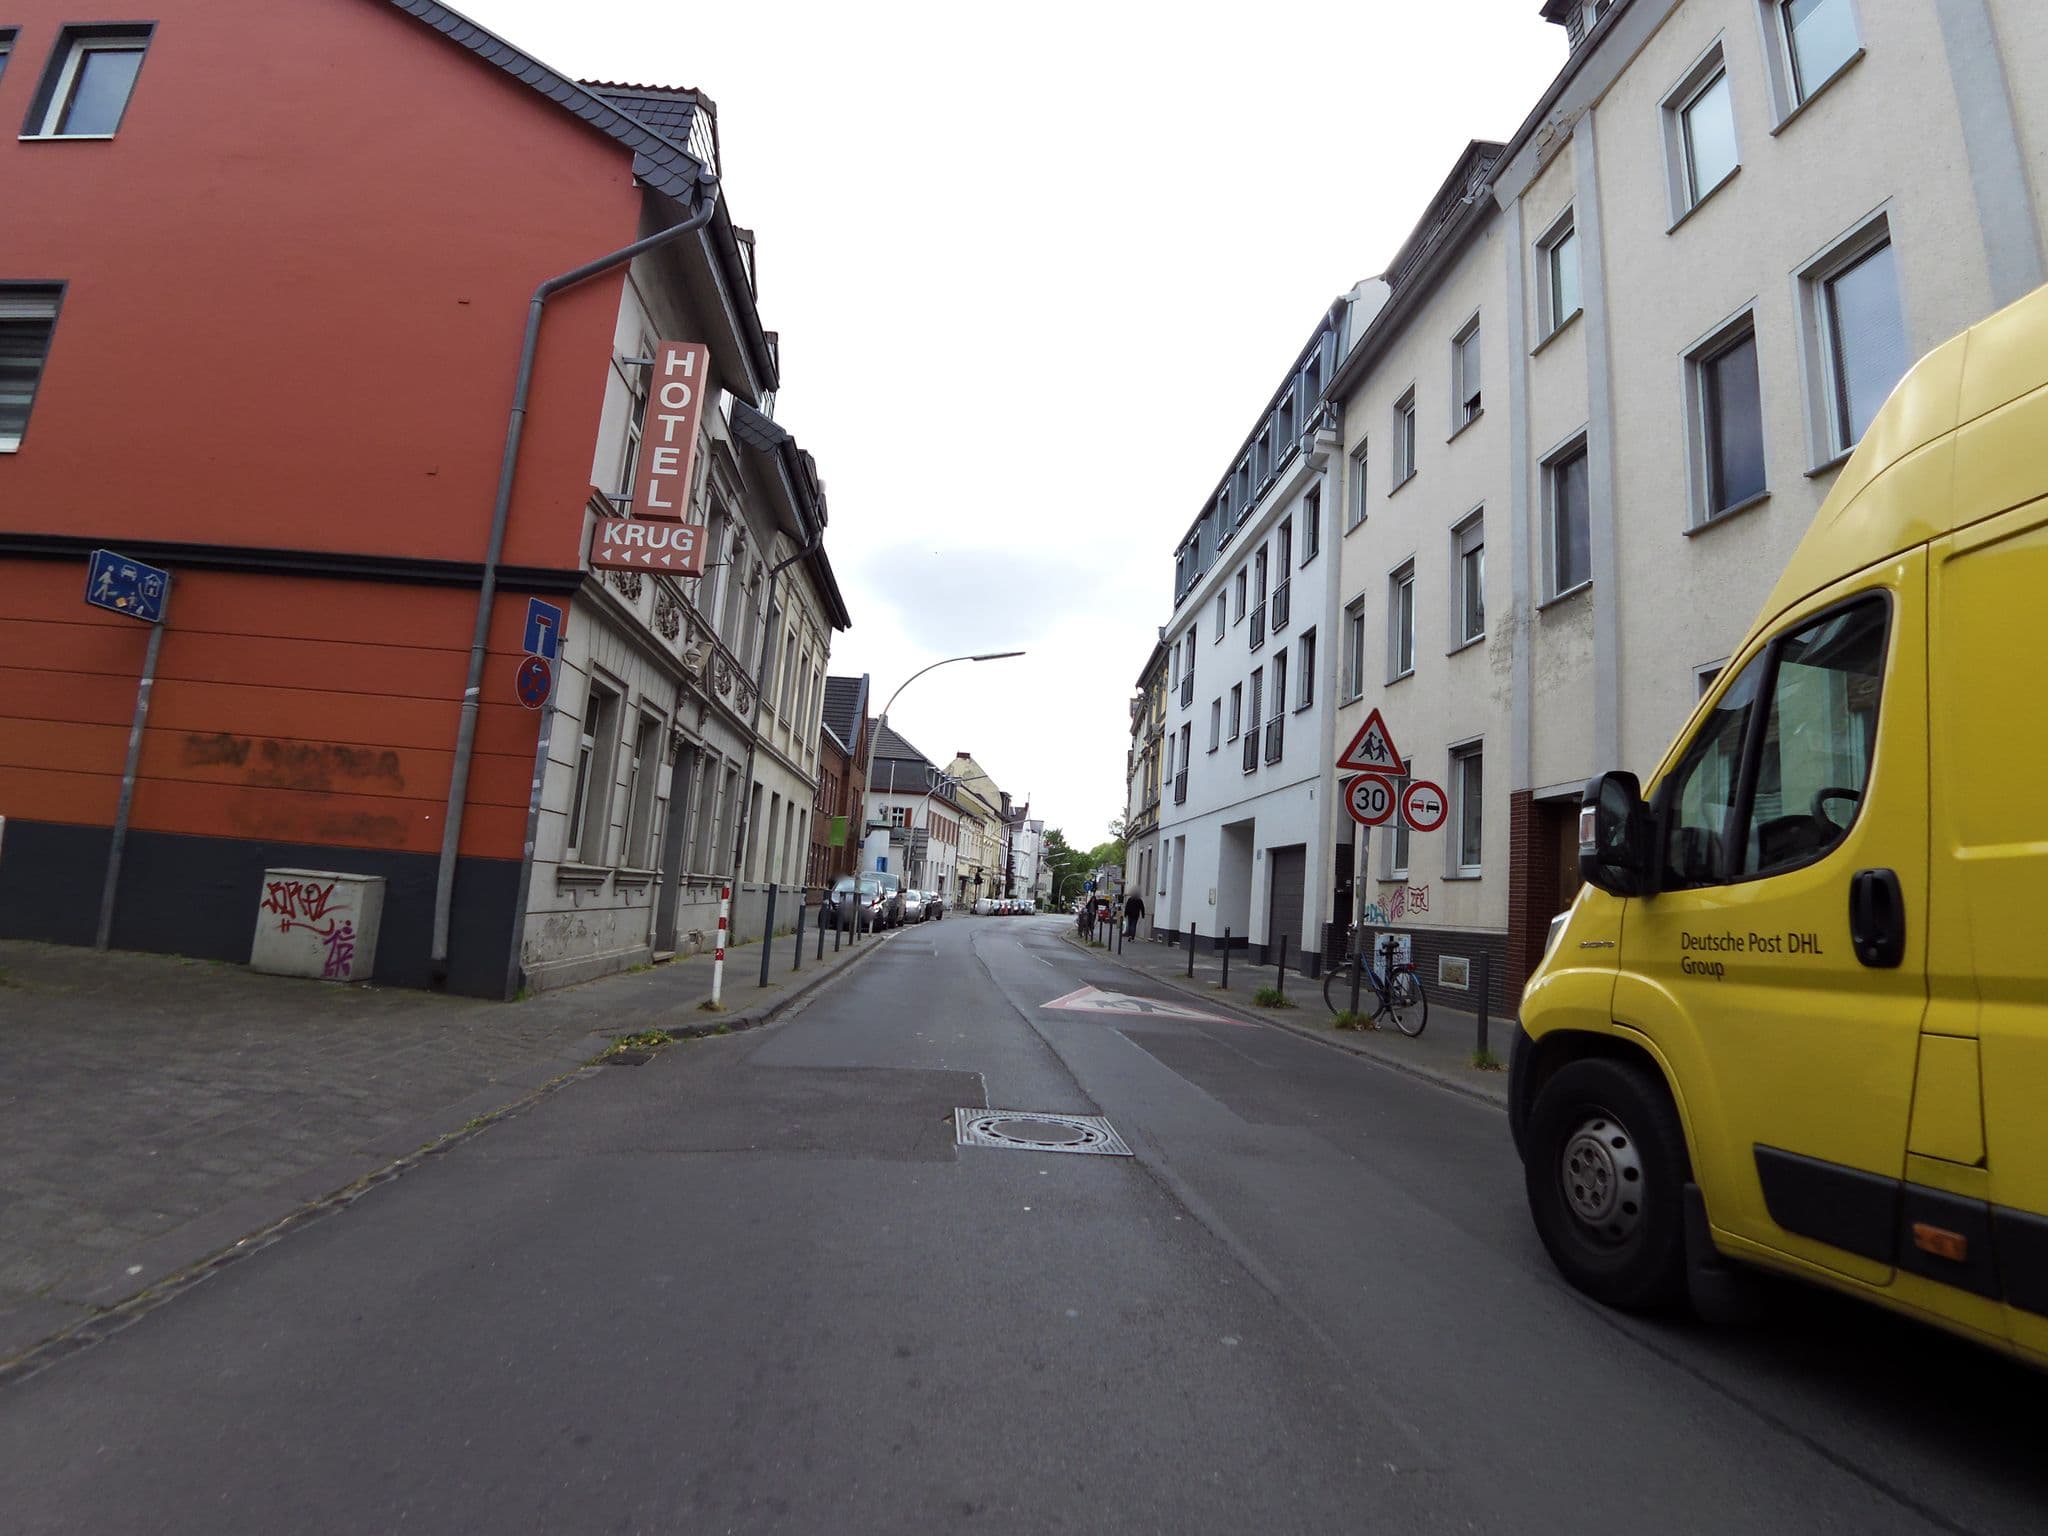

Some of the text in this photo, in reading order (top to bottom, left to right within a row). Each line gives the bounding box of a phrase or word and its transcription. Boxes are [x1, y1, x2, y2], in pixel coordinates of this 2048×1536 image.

[647, 350, 695, 508] HOTEL
[603, 522, 694, 551] KRUG
[1356, 787, 1386, 812] 30
[1681, 932, 1823, 954] Deutsche Post DHL
[1681, 956, 1725, 981] Group
